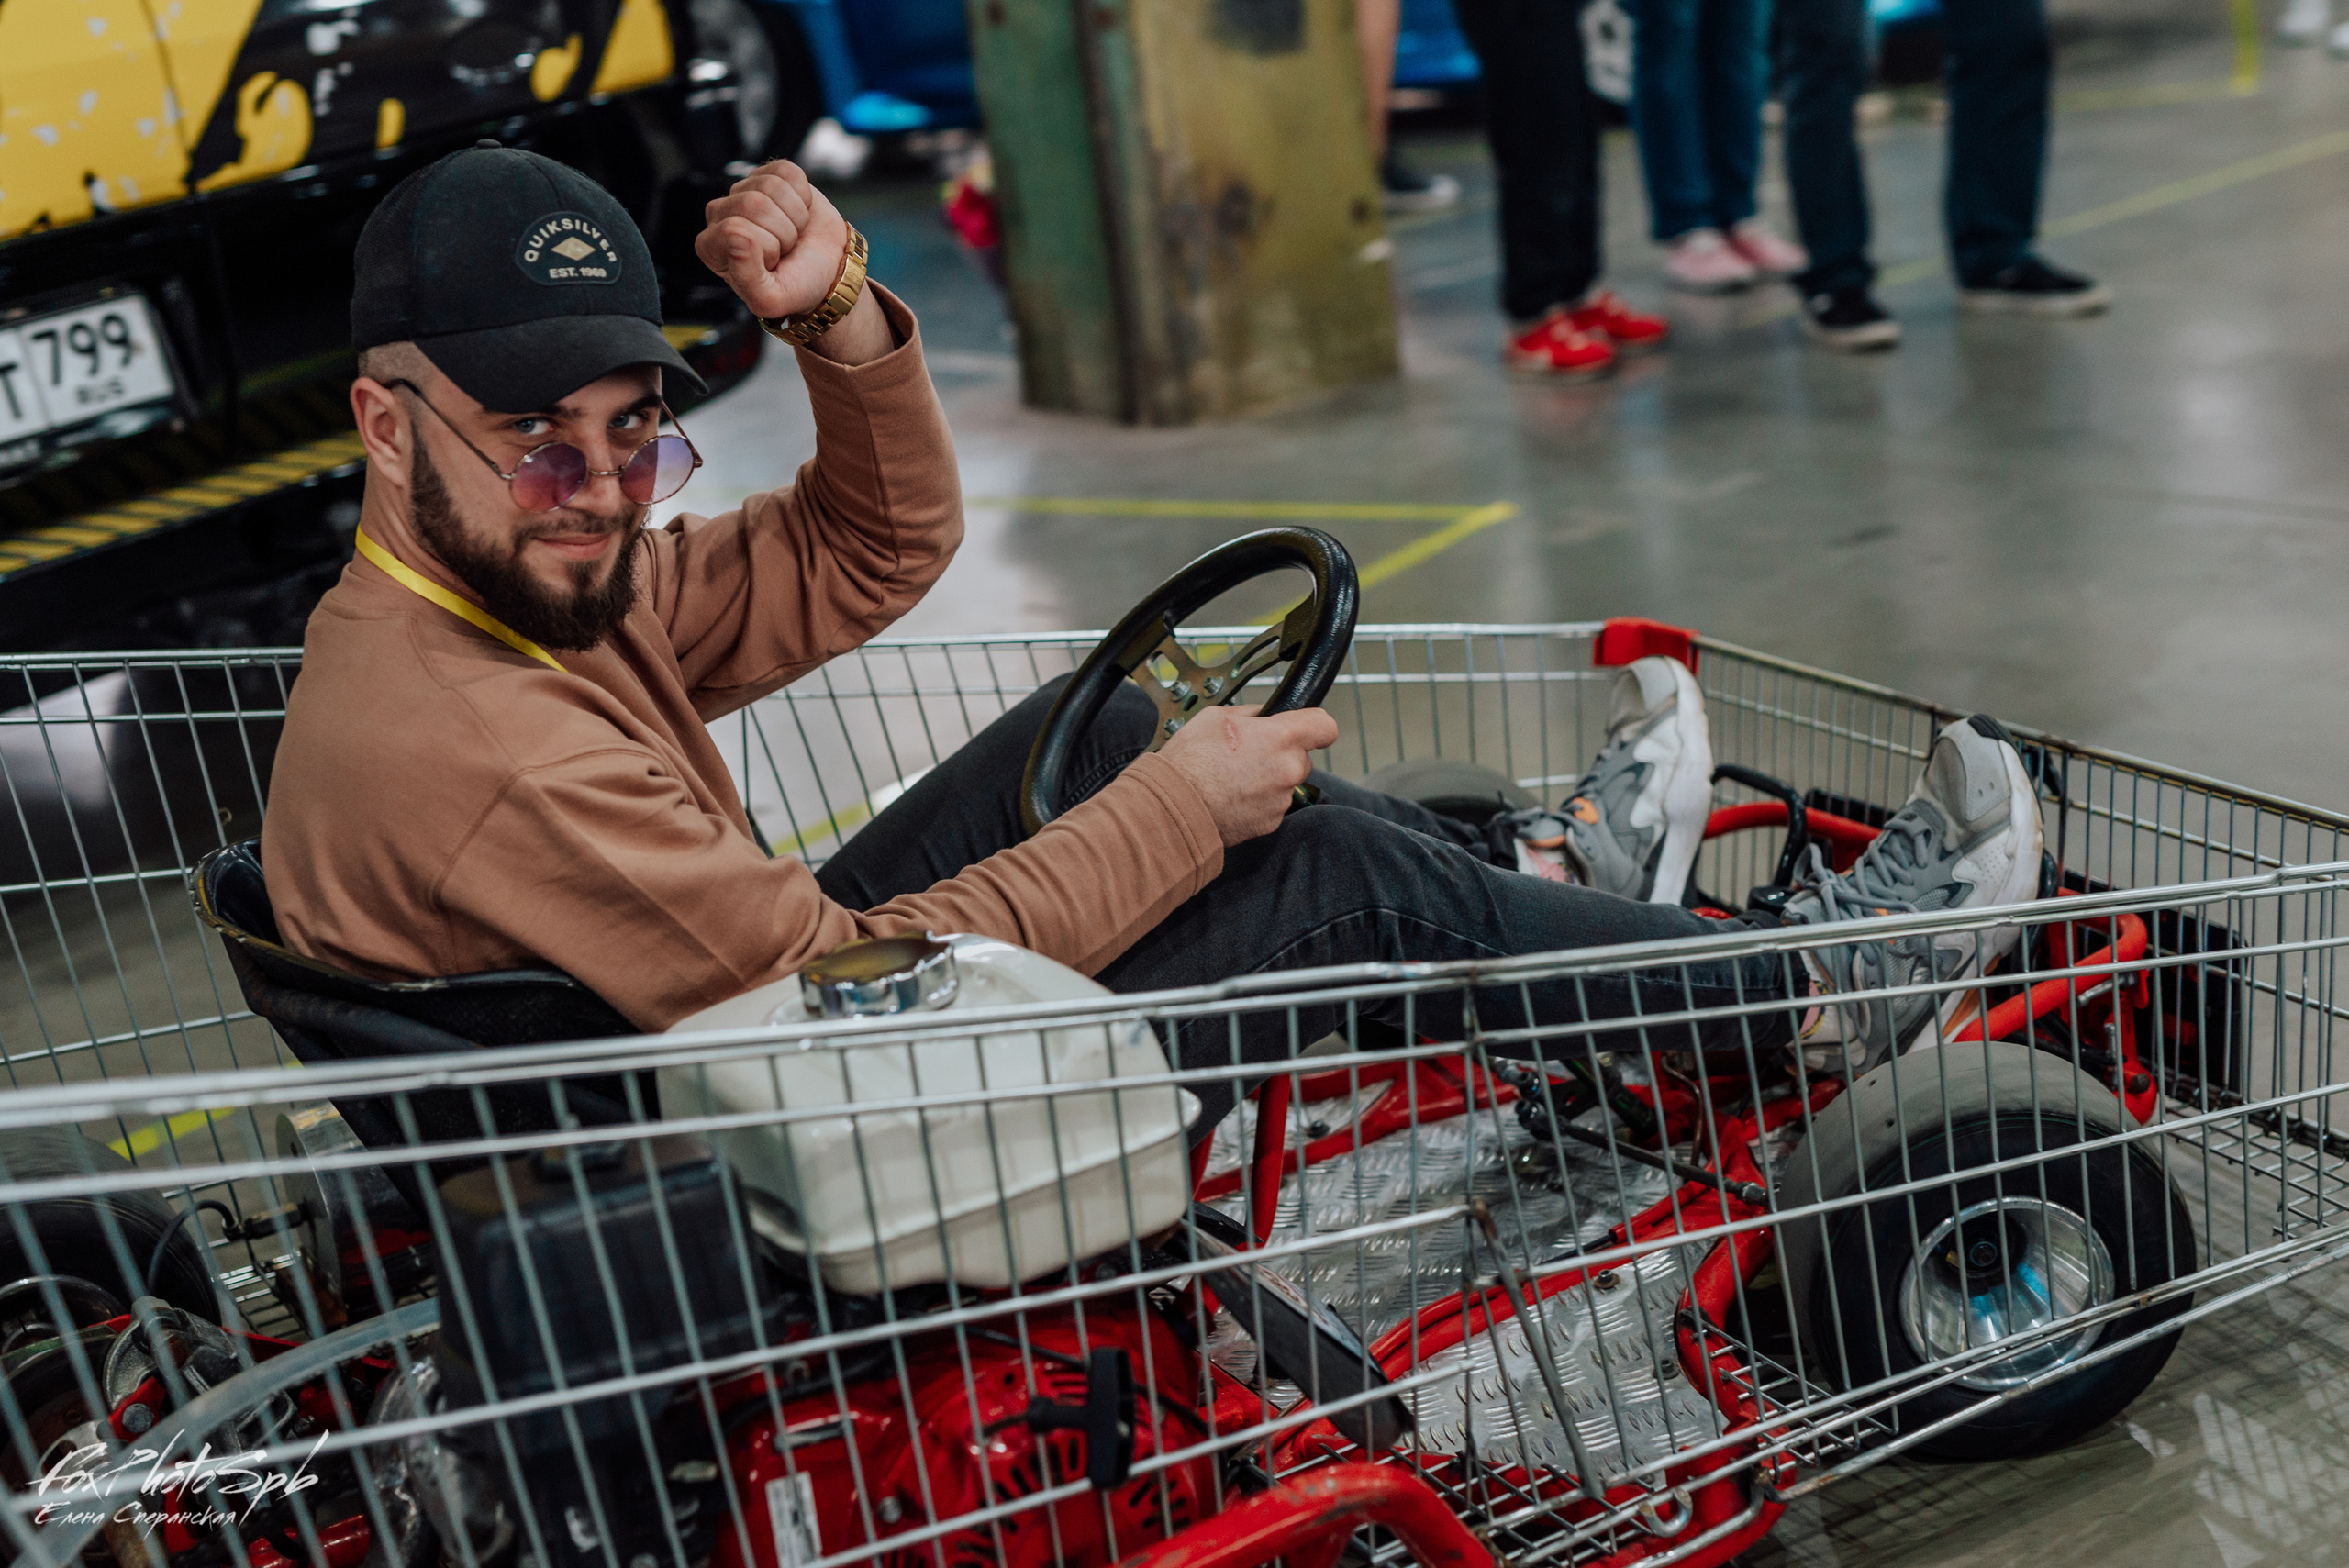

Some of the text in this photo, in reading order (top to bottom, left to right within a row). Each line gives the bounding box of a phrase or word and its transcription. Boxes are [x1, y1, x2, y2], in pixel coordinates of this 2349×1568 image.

[524, 218, 618, 262] QUIKSILVER
[549, 266, 607, 279] EST. 1969
[31, 313, 134, 387] 799
